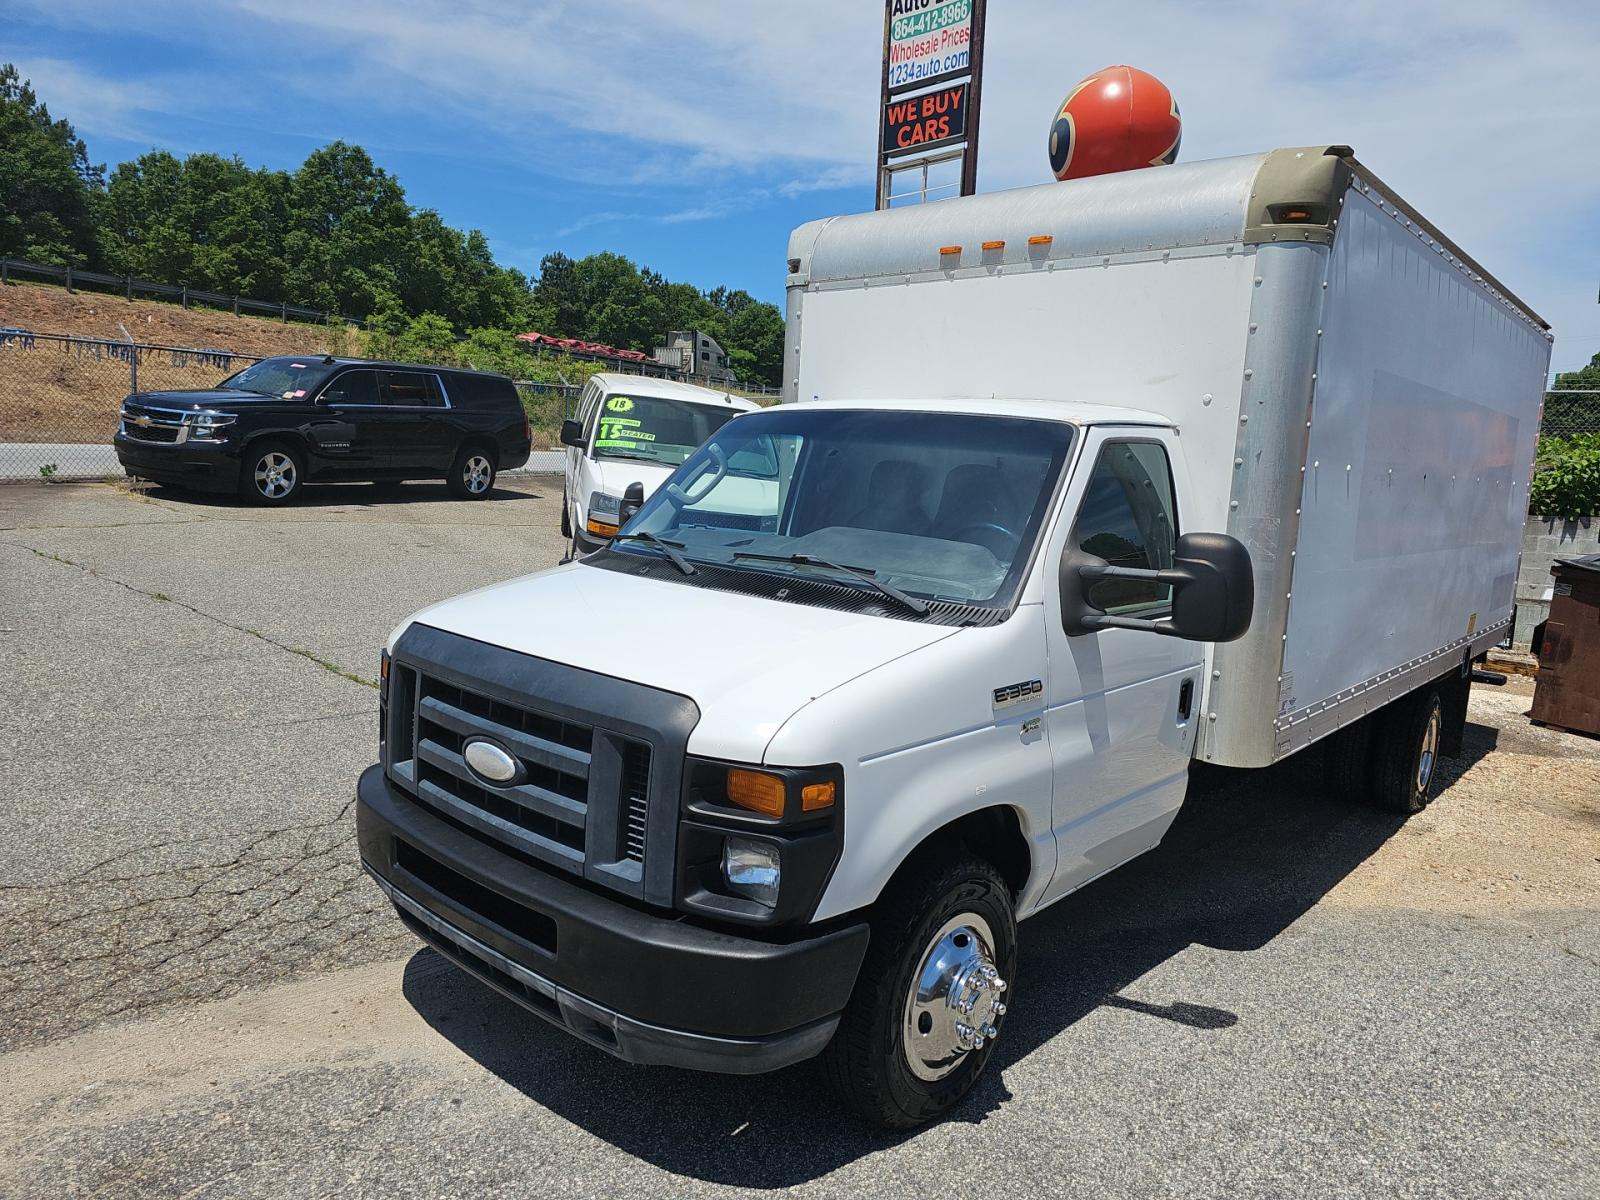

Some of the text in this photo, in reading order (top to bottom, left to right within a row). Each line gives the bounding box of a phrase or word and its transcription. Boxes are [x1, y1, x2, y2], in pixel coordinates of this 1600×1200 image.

[894, 1, 968, 40] 864-412-8966
[891, 26, 969, 64] Wholesale Prices
[890, 50, 968, 85] 1234auto.com
[888, 89, 962, 125] WE BUY
[897, 116, 950, 147] CARS
[614, 400, 626, 408] 18
[601, 424, 623, 439] 15
